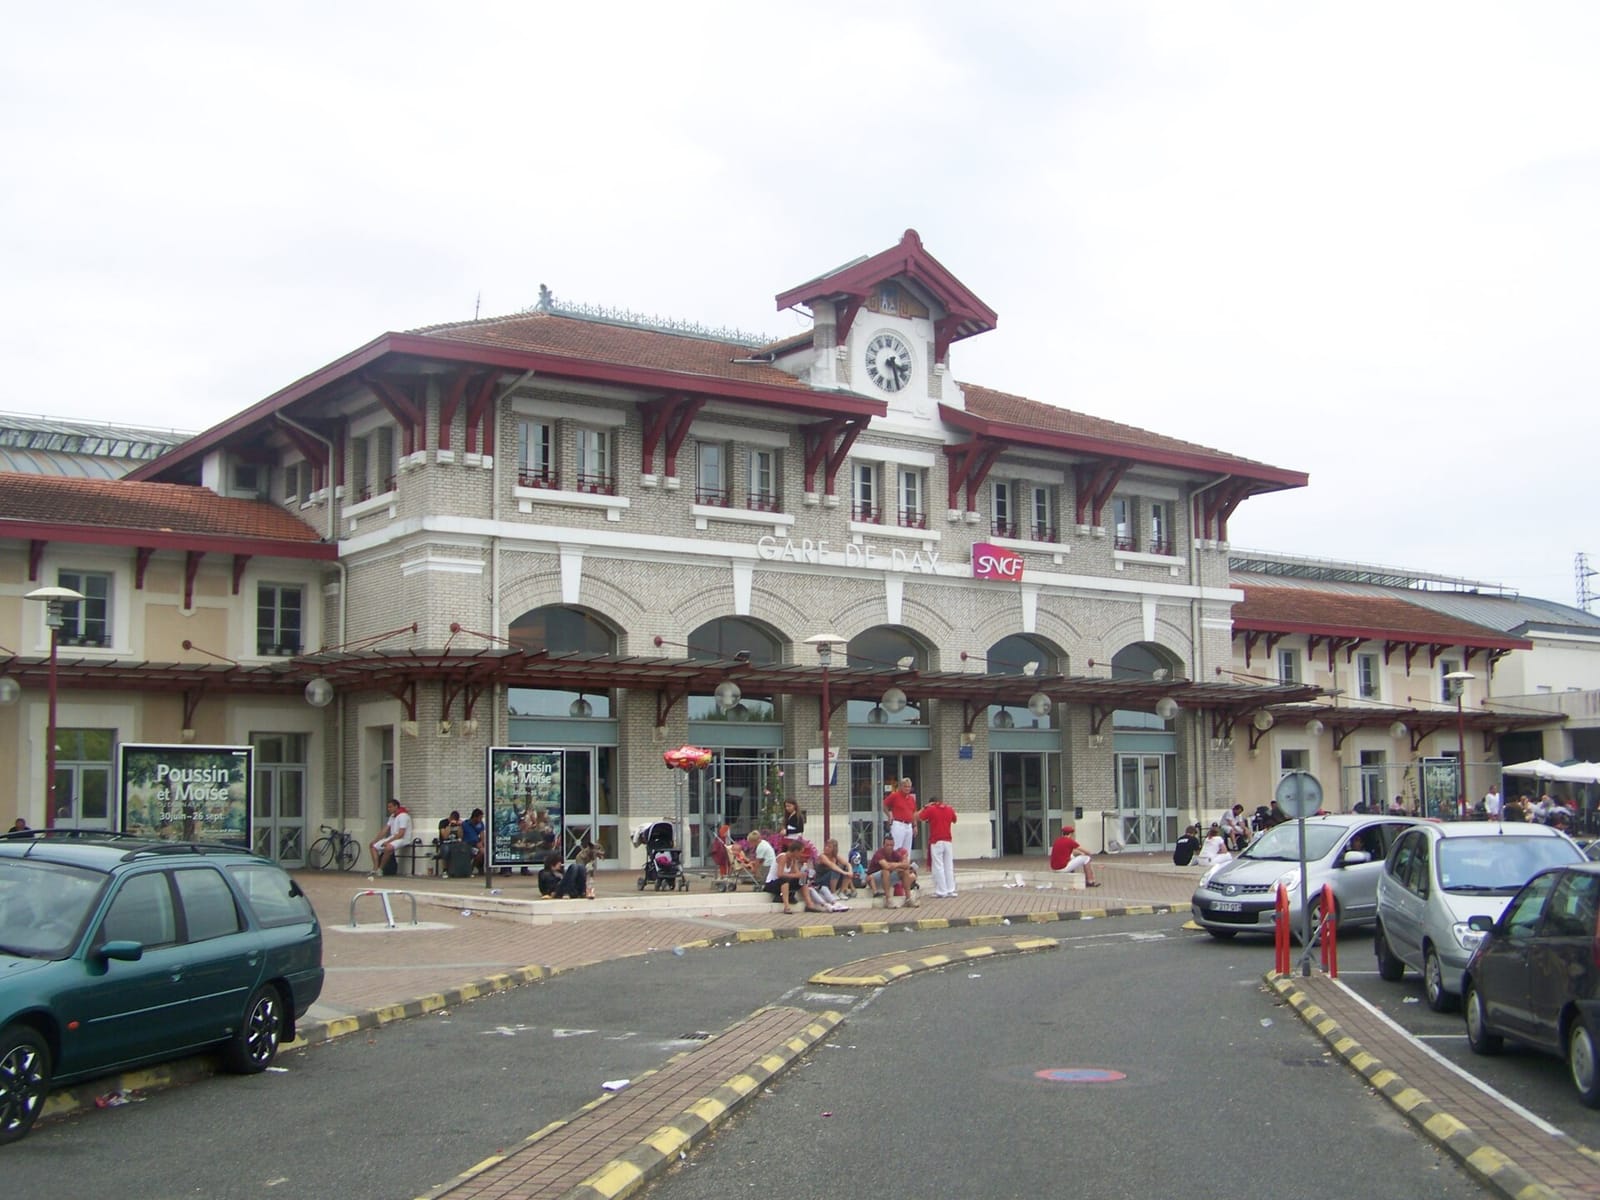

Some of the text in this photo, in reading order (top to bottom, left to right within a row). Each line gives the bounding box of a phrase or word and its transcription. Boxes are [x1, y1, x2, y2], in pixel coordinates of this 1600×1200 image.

[757, 535, 940, 576] GARE DE DAX
[976, 555, 1024, 576] SNCF
[157, 764, 229, 783] Poussin
[511, 760, 552, 773] Poussin
[157, 783, 229, 801] et Moïse
